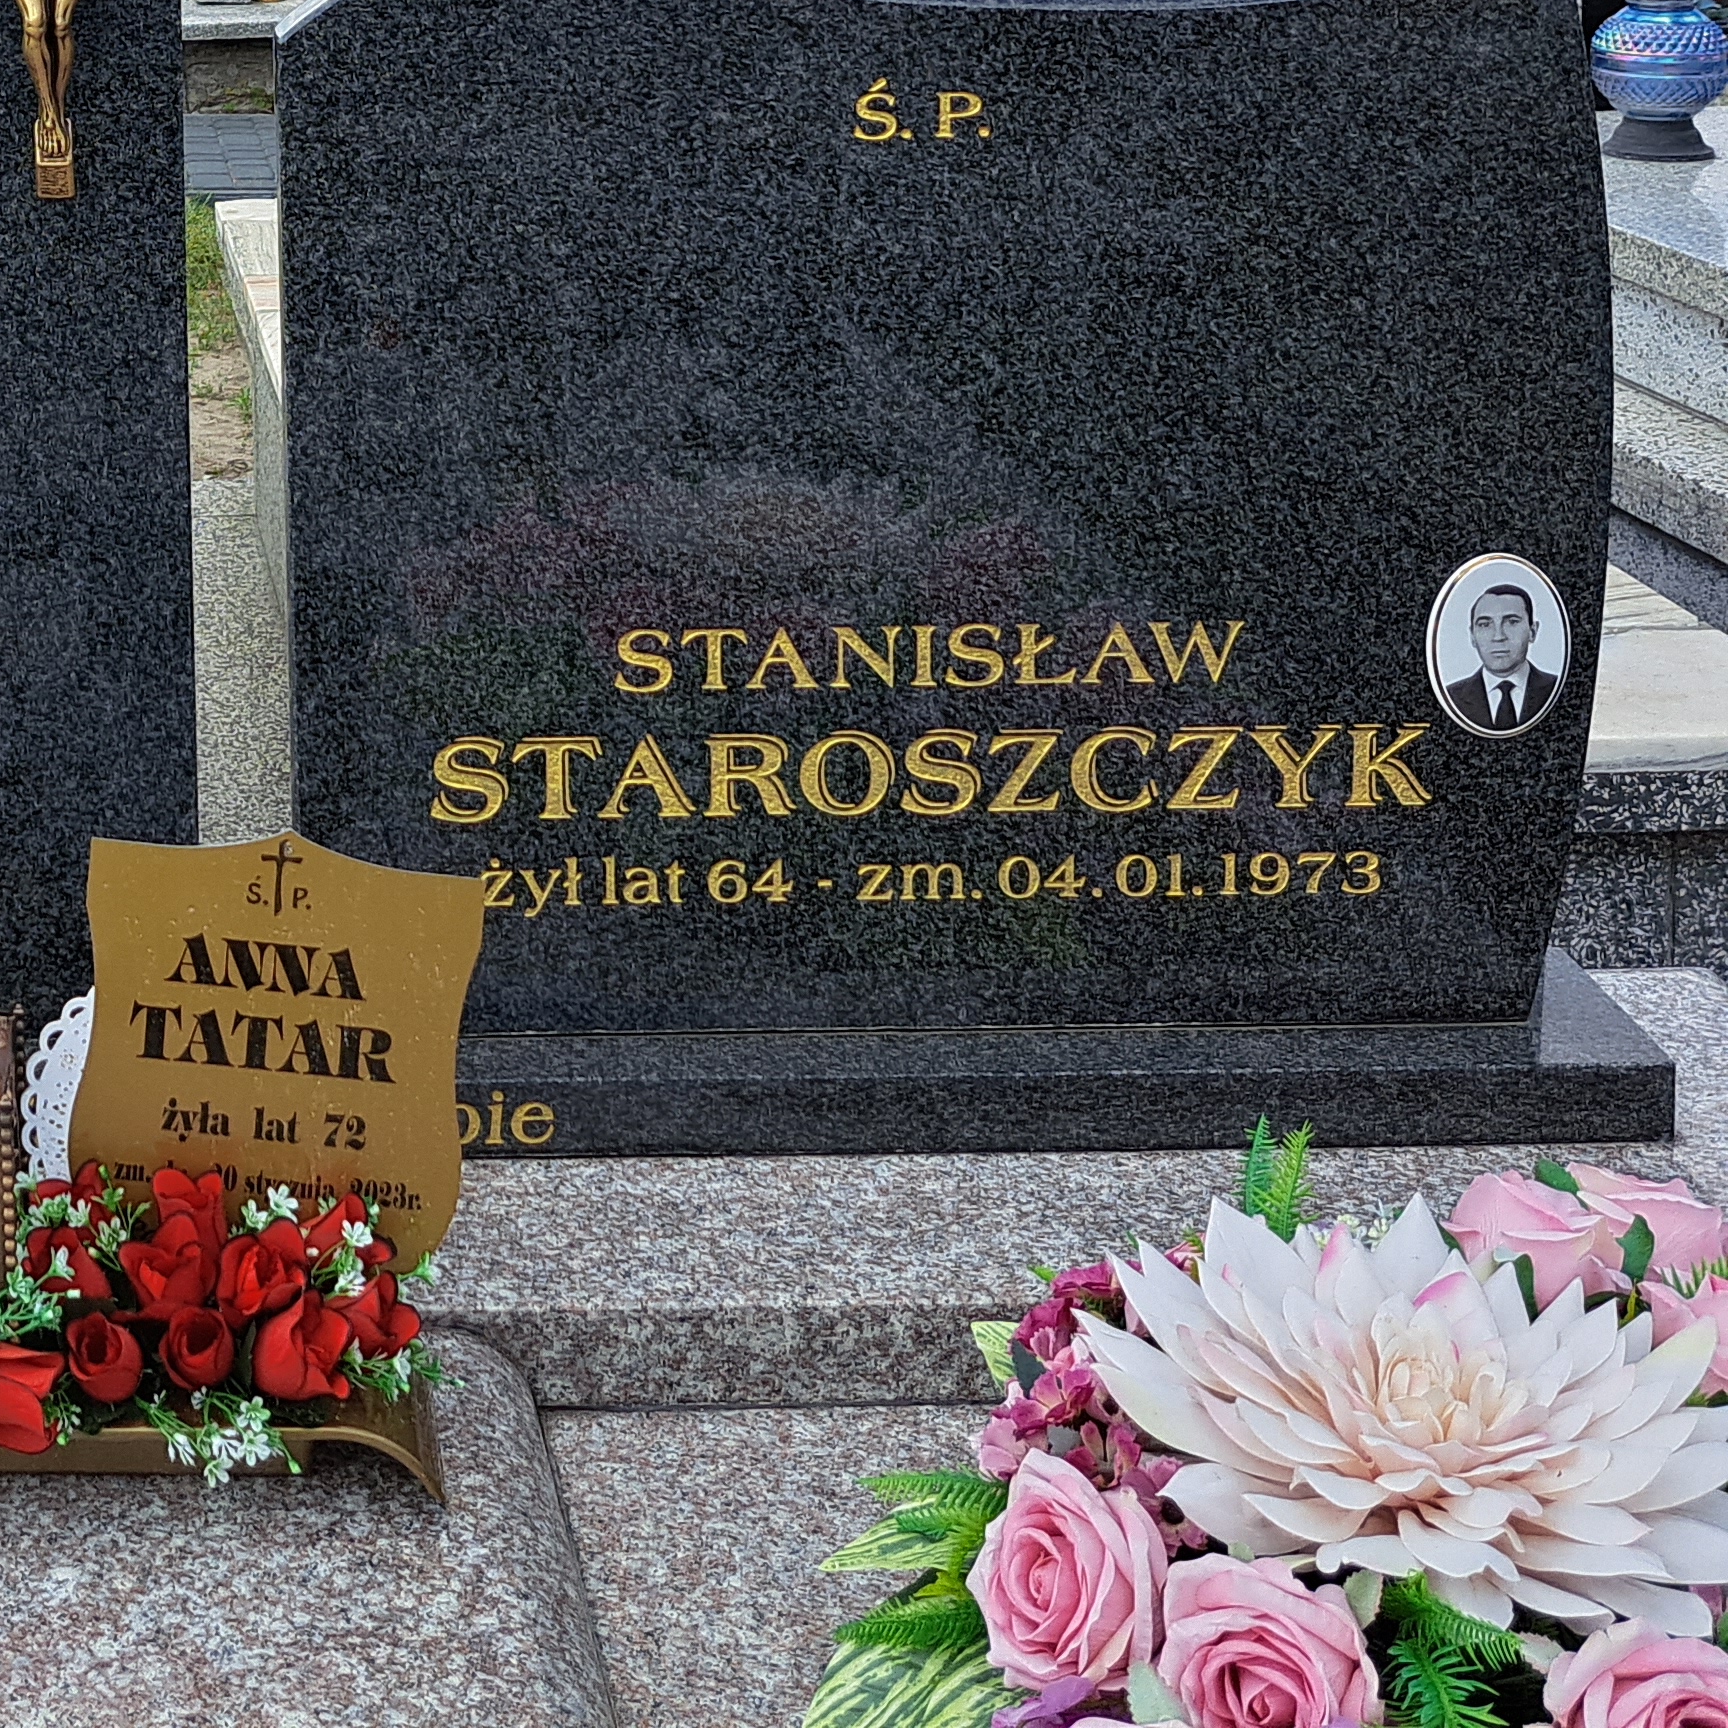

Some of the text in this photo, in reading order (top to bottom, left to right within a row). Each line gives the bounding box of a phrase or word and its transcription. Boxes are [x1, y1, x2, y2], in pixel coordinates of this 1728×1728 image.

[853, 77, 992, 141] Ś. P.
[614, 619, 1246, 695] STANISŁAW
[429, 721, 1434, 825] STAROSZCZYK
[246, 874, 312, 911] Ś. P.
[481, 857, 584, 919] żył
[601, 855, 687, 906] lat
[706, 857, 795, 906] 64
[164, 932, 367, 1002] ANNA
[129, 999, 397, 1084] TATAR
[253, 1106, 301, 1144] lat
[323, 1113, 368, 1152] 72
[113, 1161, 152, 1184] zm.
